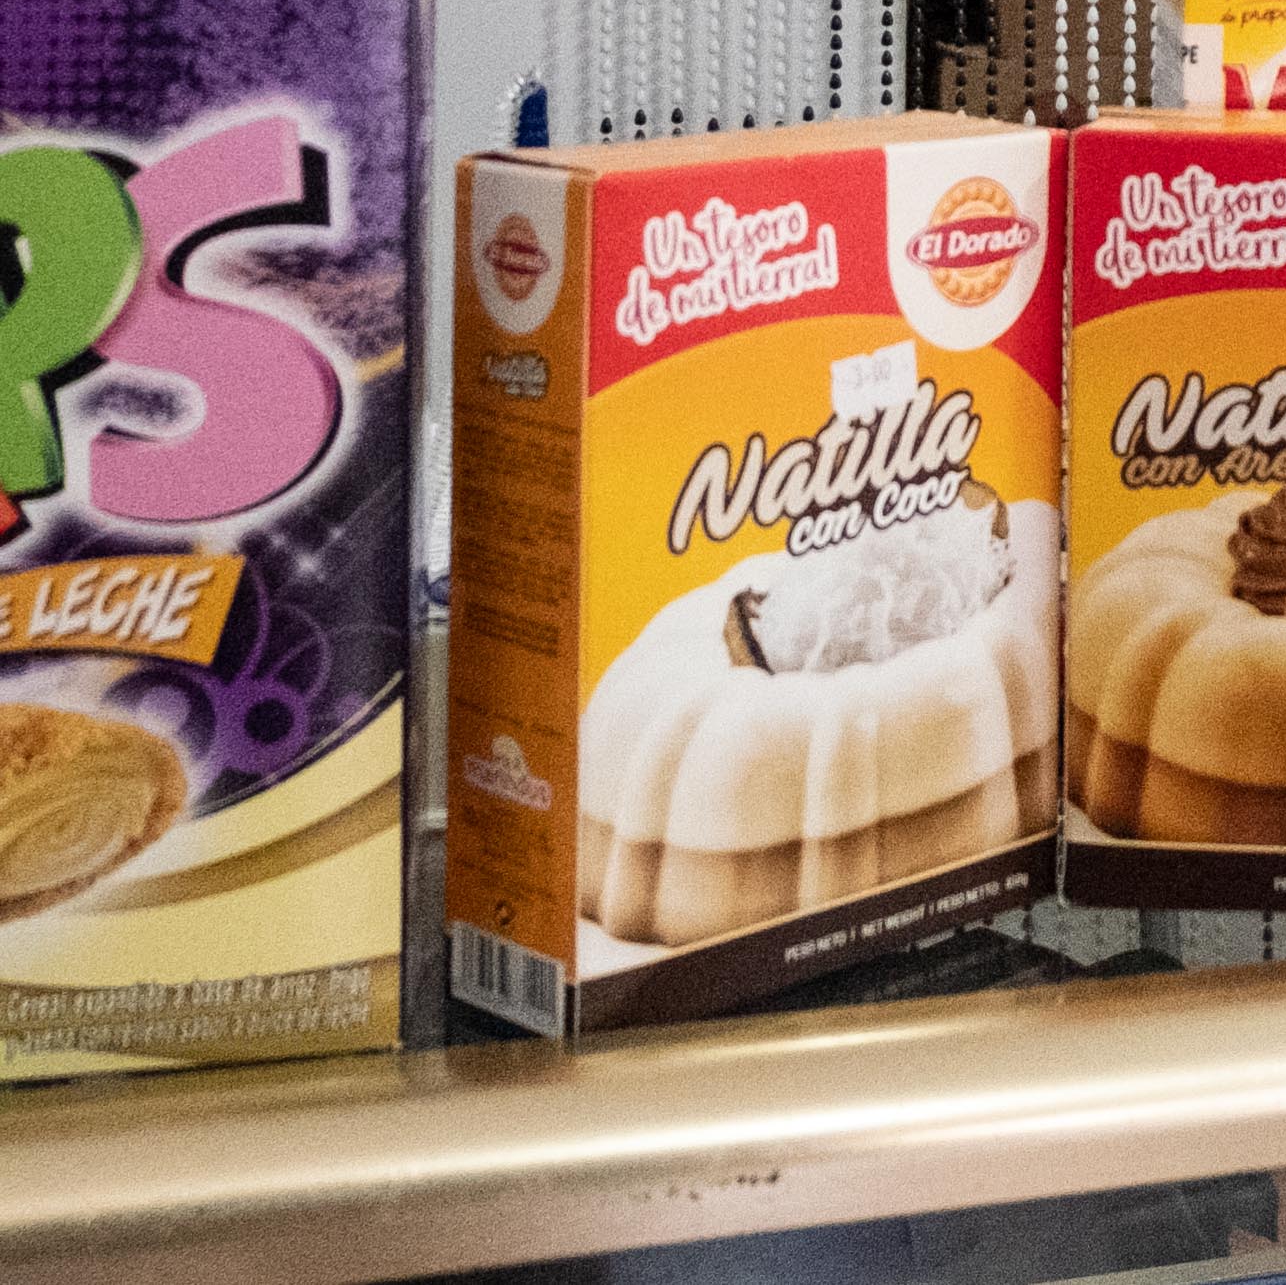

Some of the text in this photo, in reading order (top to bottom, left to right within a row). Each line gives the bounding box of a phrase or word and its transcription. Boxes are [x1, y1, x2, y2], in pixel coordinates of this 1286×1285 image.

[1129, 177, 1182, 226] Un
[647, 202, 803, 269] Un tesoro
[918, 224, 1034, 261] El Dorado
[668, 379, 981, 556] Natilla
[1123, 447, 1206, 486] con
[787, 467, 970, 556] con Coco
[28, 565, 215, 644] LECHE
